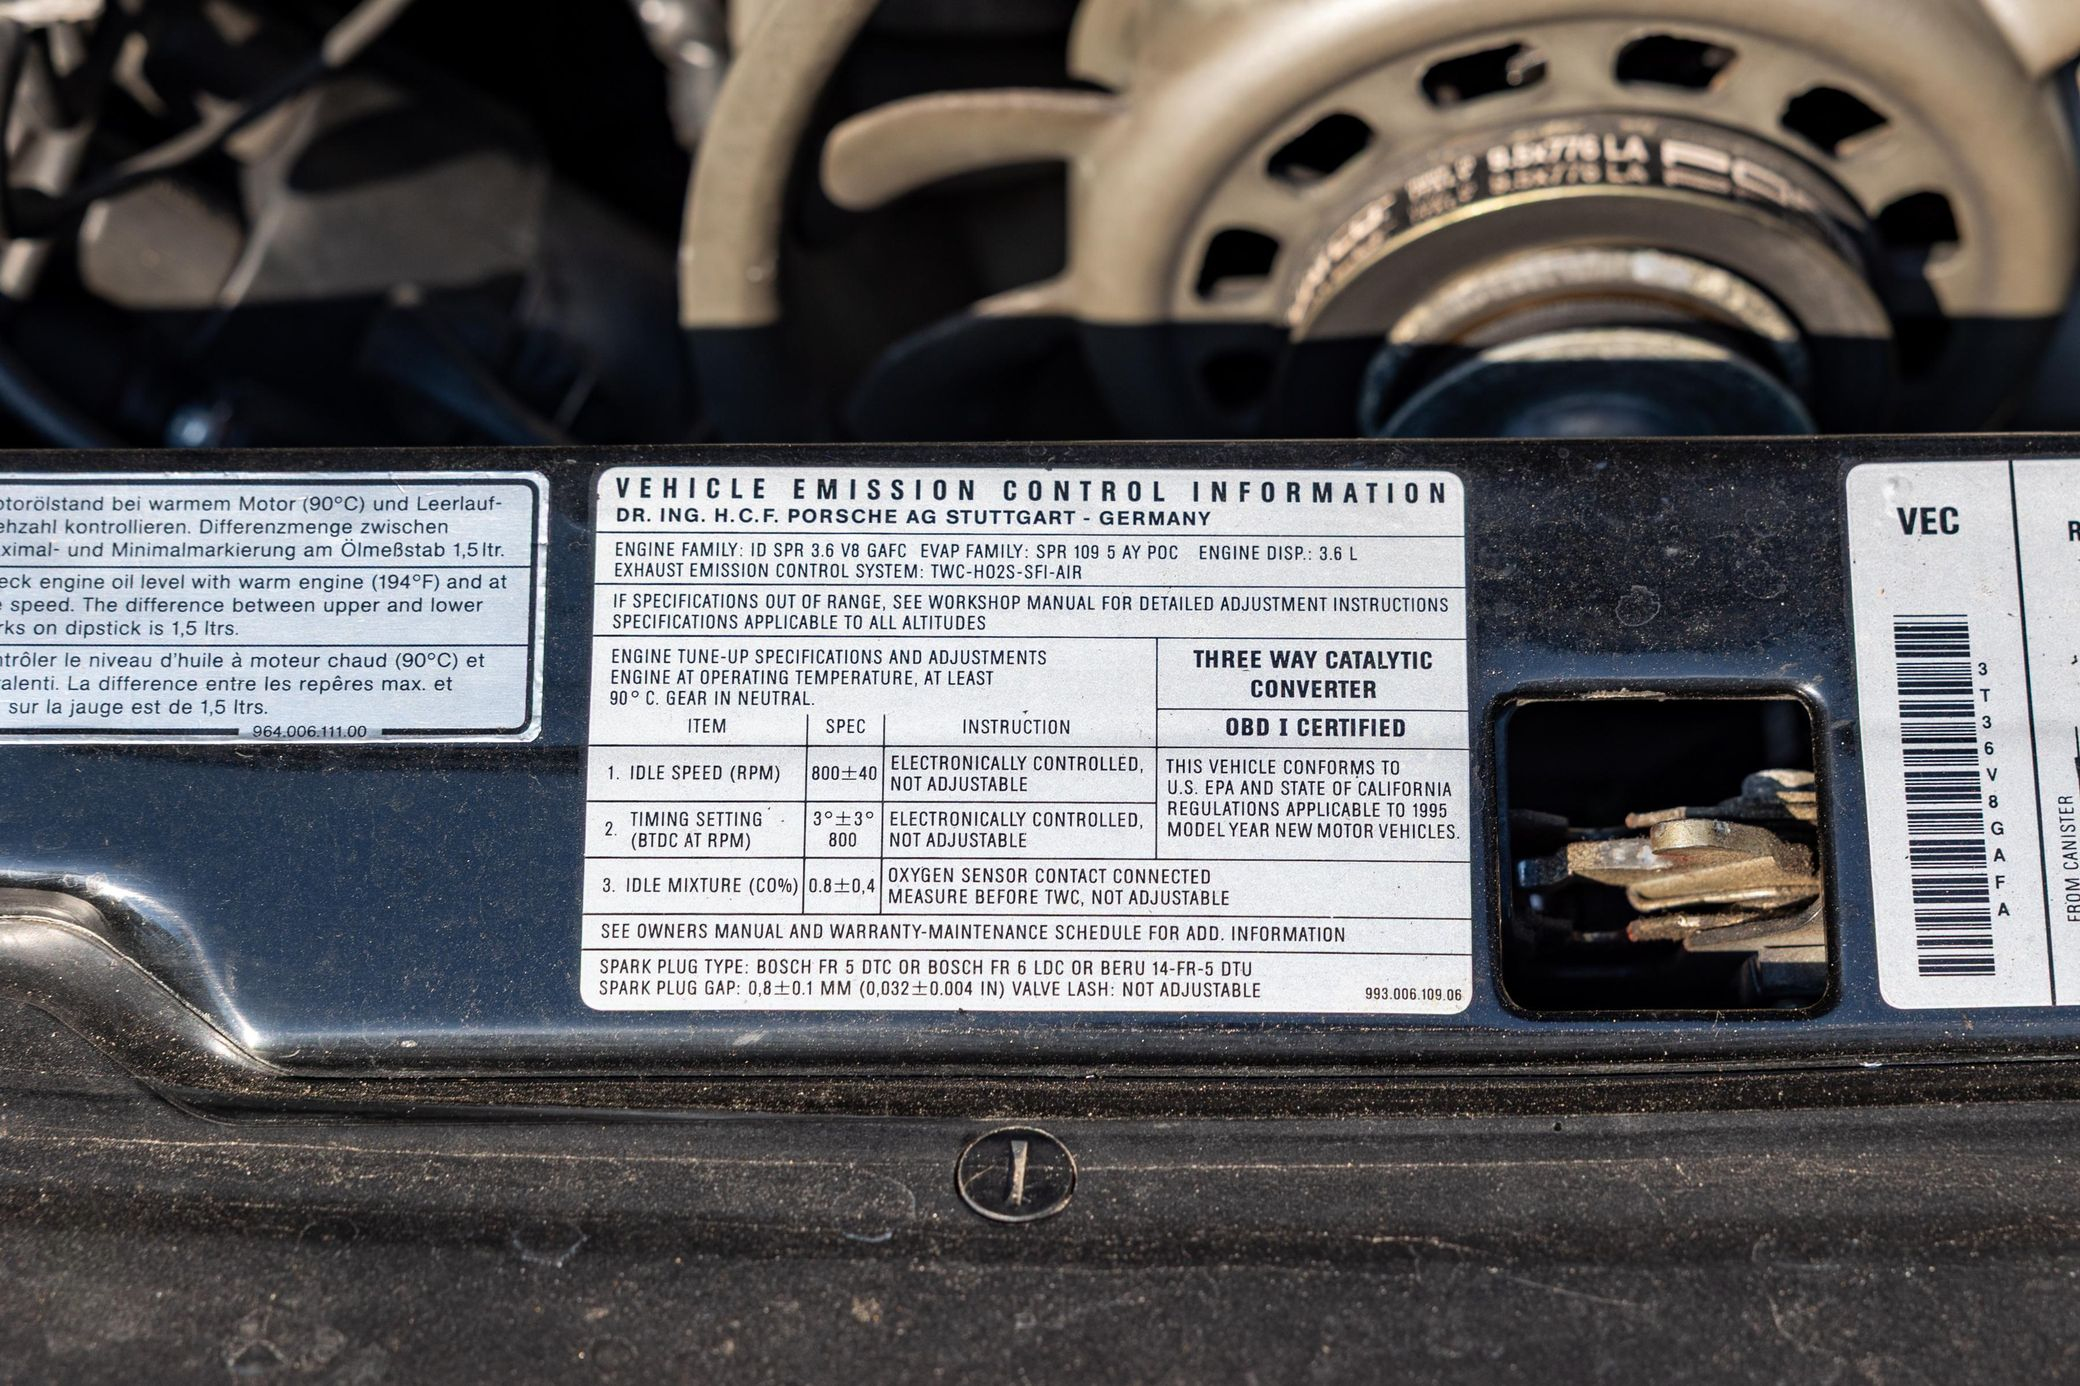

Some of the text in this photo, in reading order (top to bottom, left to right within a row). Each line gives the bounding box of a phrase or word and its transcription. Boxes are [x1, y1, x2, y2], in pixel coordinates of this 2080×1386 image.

[616, 477, 1445, 504] VEHICLE EMISSION CONTROL INFORMATION
[616, 507, 651, 522] DR.
[660, 507, 705, 523] ING.
[715, 507, 778, 523] H.C.F.
[788, 508, 897, 524] PORSCHE
[906, 509, 936, 524] AG
[946, 509, 1076, 525] STUTTGART
[1099, 510, 1211, 526] GERMANY
[1896, 506, 1960, 536] VEC
[65, 519, 191, 535] kontrollieren.
[199, 519, 353, 538] Differenzmenge
[360, 519, 448, 535] zwischen
[68, 542, 104, 557] und
[112, 542, 296, 561] Minimalmarkierung
[303, 545, 332, 558] am
[341, 538, 445, 558] Ölmeßstab
[453, 542, 478, 559] 1,5
[482, 542, 504, 557] ltr.
[615, 541, 675, 557] ENGINE
[682, 542, 743, 557] FAMILY:
[773, 542, 804, 558] SPR
[811, 542, 834, 558] 3.6
[841, 543, 860, 558] V8
[867, 542, 907, 558] GAFC
[921, 543, 960, 558] EVAP
[966, 543, 1028, 559] FAMILY:
[1036, 544, 1067, 559] SPR
[1074, 544, 1099, 560] 109
[1107, 545, 1116, 560] 5
[1122, 544, 1141, 560] AY
[1147, 544, 1178, 560] POC
[1199, 545, 1260, 561] ENGINE
[1267, 545, 1312, 561] DISP.:
[1319, 546, 1342, 561] 3.6
[1350, 546, 1358, 561] L
[39, 574, 105, 593] engine
[112, 574, 134, 590] oil
[141, 574, 185, 590] level
[191, 574, 231, 590] with
[238, 577, 291, 590] warm
[299, 574, 364, 593] engine
[446, 574, 482, 589] and
[489, 574, 507, 589] at
[613, 593, 1449, 613] IF SPECIFICATIONS OUT OF RANGE, SEE WORKSHOP MANUAL FOR DETAILED ADJUSTMENT INSTRUCTIONS
[0, 651, 57, 668] trôler
[65, 652, 81, 668] le
[89, 652, 152, 668] niveau
[231, 652, 242, 668] à
[250, 653, 321, 668] moteur
[327, 652, 387, 668] chaud
[466, 653, 485, 668] et
[611, 648, 1047, 665] ENGINE TUNE-UP SPECIFICATIONS AND ADJUSTMENTS
[1193, 649, 1433, 670] THREE WAY CATALYTIC
[646, 690, 659, 706] C.
[666, 690, 707, 706] GEAR
[714, 690, 731, 706] IN
[738, 690, 815, 706] NEUTRAL.
[1250, 679, 1377, 699] CONVERTER
[248, 725, 370, 740] 964.006.111.00
[688, 718, 726, 734] ITEM
[826, 718, 866, 734] SPEC
[963, 719, 1070, 735] INSTRUCTION
[1225, 717, 1406, 738] OBD I CERTIFIED
[608, 764, 780, 784] 1. IDLE SPEED (RPM)
[891, 755, 1143, 774] ELECTRONICALLY CONTROLLED,
[1165, 758, 1400, 776] THIS VEHICLE CONFORMS TO
[890, 776, 1028, 792] NOT ADJUSTABLE
[1168, 800, 1447, 818] REGULATIONS APPLICABLE TO 1995
[605, 821, 617, 836] 2.
[630, 811, 762, 827] TIMING SETTING
[828, 832, 857, 848] 800
[1167, 821, 1460, 840] MODEL YEAR NEW MOTOR VEHICLES.
[631, 832, 751, 851] (BTDC AT RPM)
[2058, 795, 2080, 922] FROM CANISTER
[602, 877, 799, 896] 3. IDLE MIXTURE (CO%)
[601, 923, 1345, 943] SEE OWNERS MANUAL AND WARRANTY-MAINTENANCE SCHEDULE FOR ADD. INFORMATION
[599, 980, 651, 996] SPARK
[657, 980, 697, 996] PLUG
[705, 980, 740, 996] GAP:
[821, 980, 851, 996] MM
[981, 980, 1005, 999] IN)
[1012, 981, 1060, 997] VALVE
[1068, 981, 1114, 997] LASH:
[1122, 981, 1154, 997] NOT
[1159, 982, 1261, 998] ADJUSTABLE
[1365, 987, 1462, 1001] 993.006.109.06
